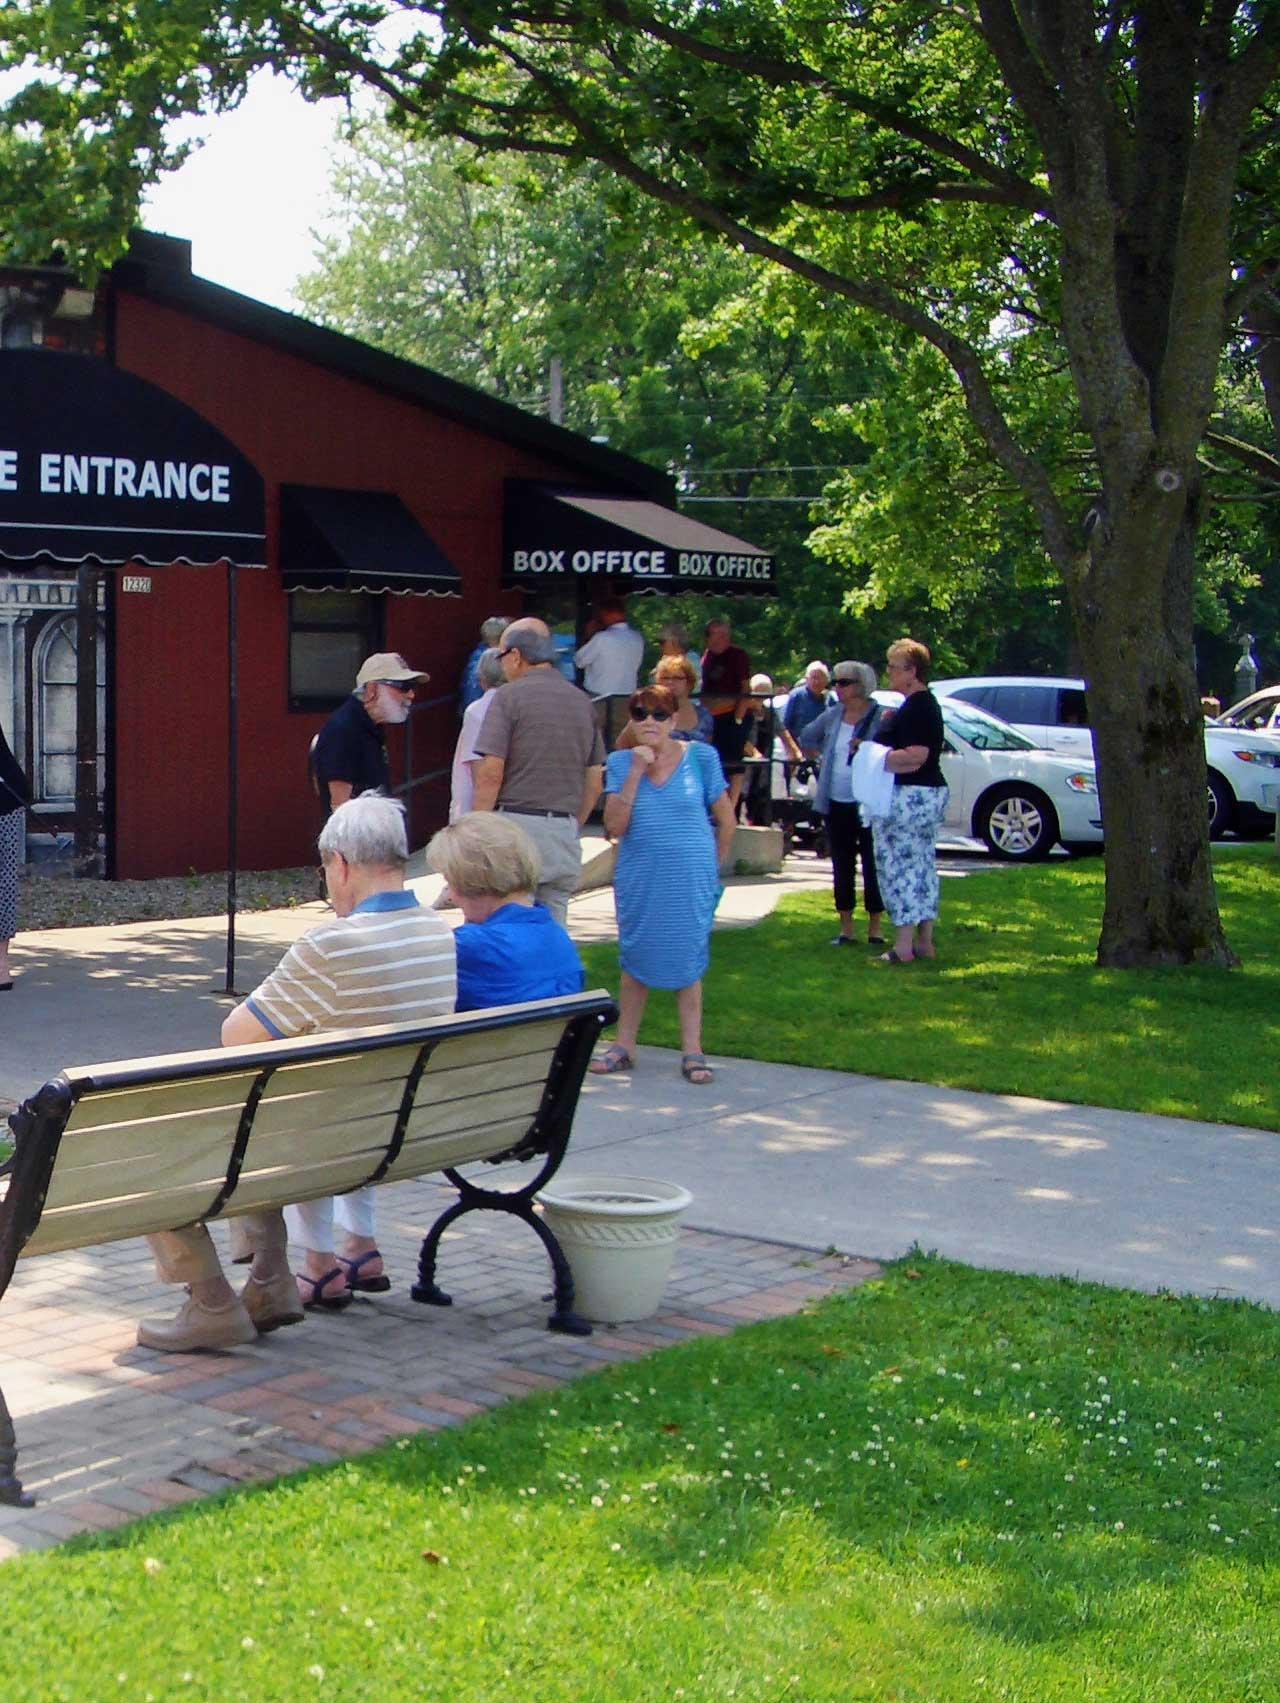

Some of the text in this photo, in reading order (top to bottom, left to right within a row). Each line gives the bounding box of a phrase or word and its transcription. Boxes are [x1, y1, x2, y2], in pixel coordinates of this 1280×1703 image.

[39, 453, 231, 503] ENTRANCE
[513, 550, 665, 573] BOX OFFICE
[678, 553, 771, 579] BOX OFFICE
